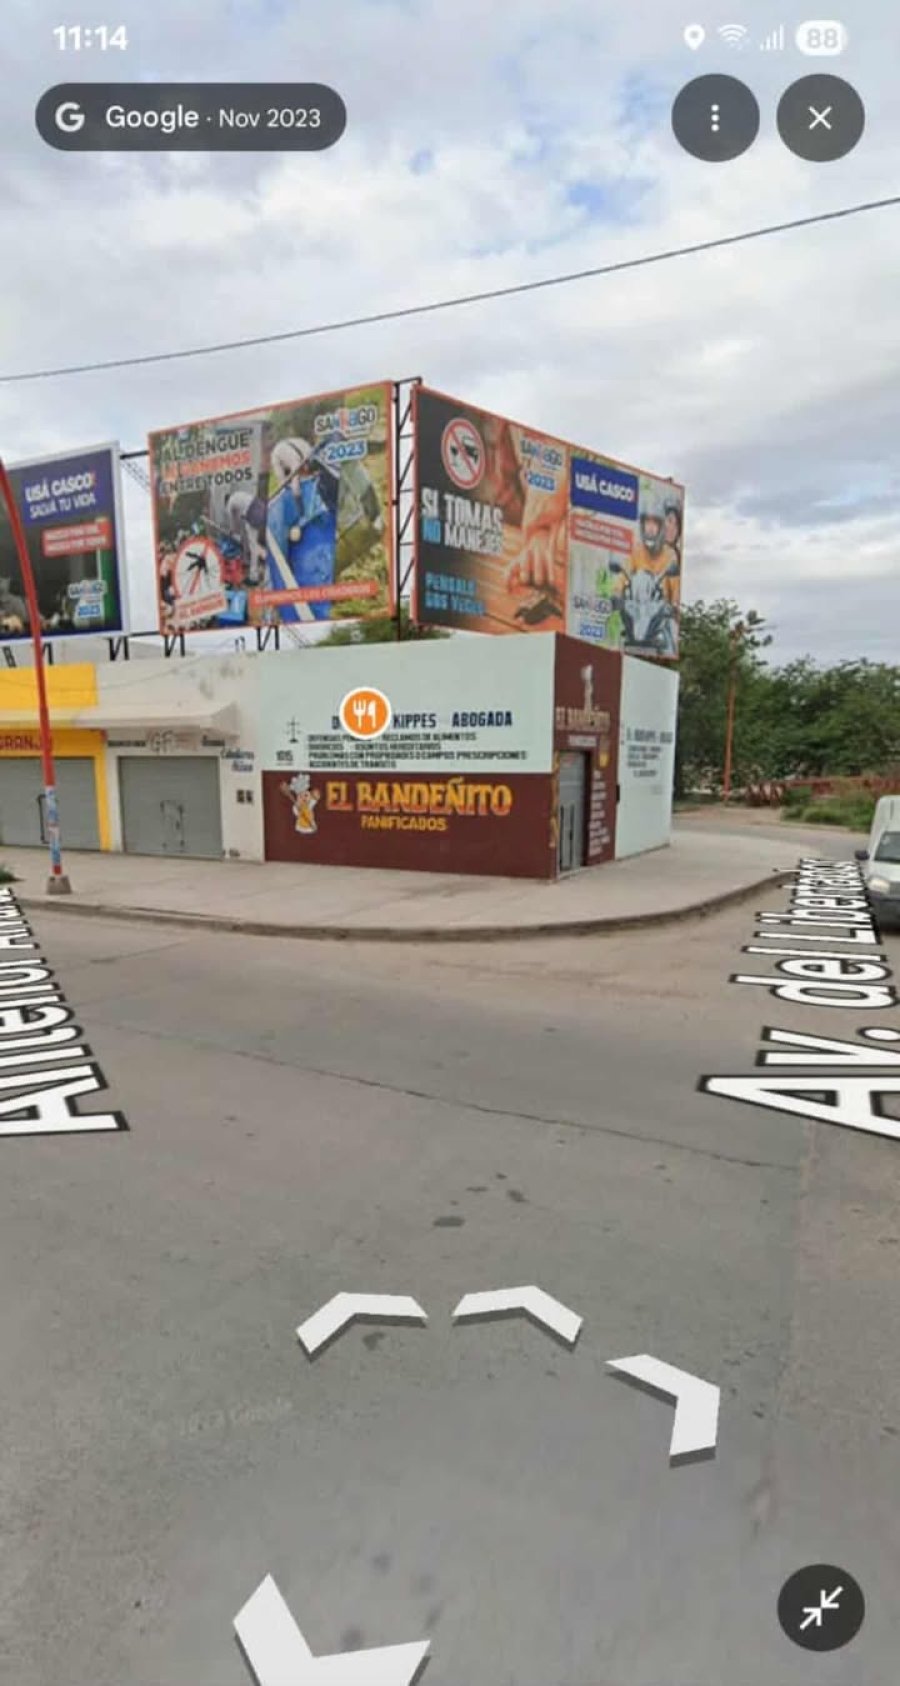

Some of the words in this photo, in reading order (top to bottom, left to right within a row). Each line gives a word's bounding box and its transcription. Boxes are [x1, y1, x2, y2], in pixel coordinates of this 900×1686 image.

[207, 466, 252, 486] TODOS
[421, 487, 438, 516] SI
[444, 494, 503, 533] TOMAS
[423, 518, 441, 543] NO
[393, 713, 437, 730] KIPPES
[452, 710, 514, 728] ABOGADA
[326, 780, 353, 811] EL
[356, 776, 513, 817] BANDEÑITO
[360, 815, 447, 832] PANIFICADOS
